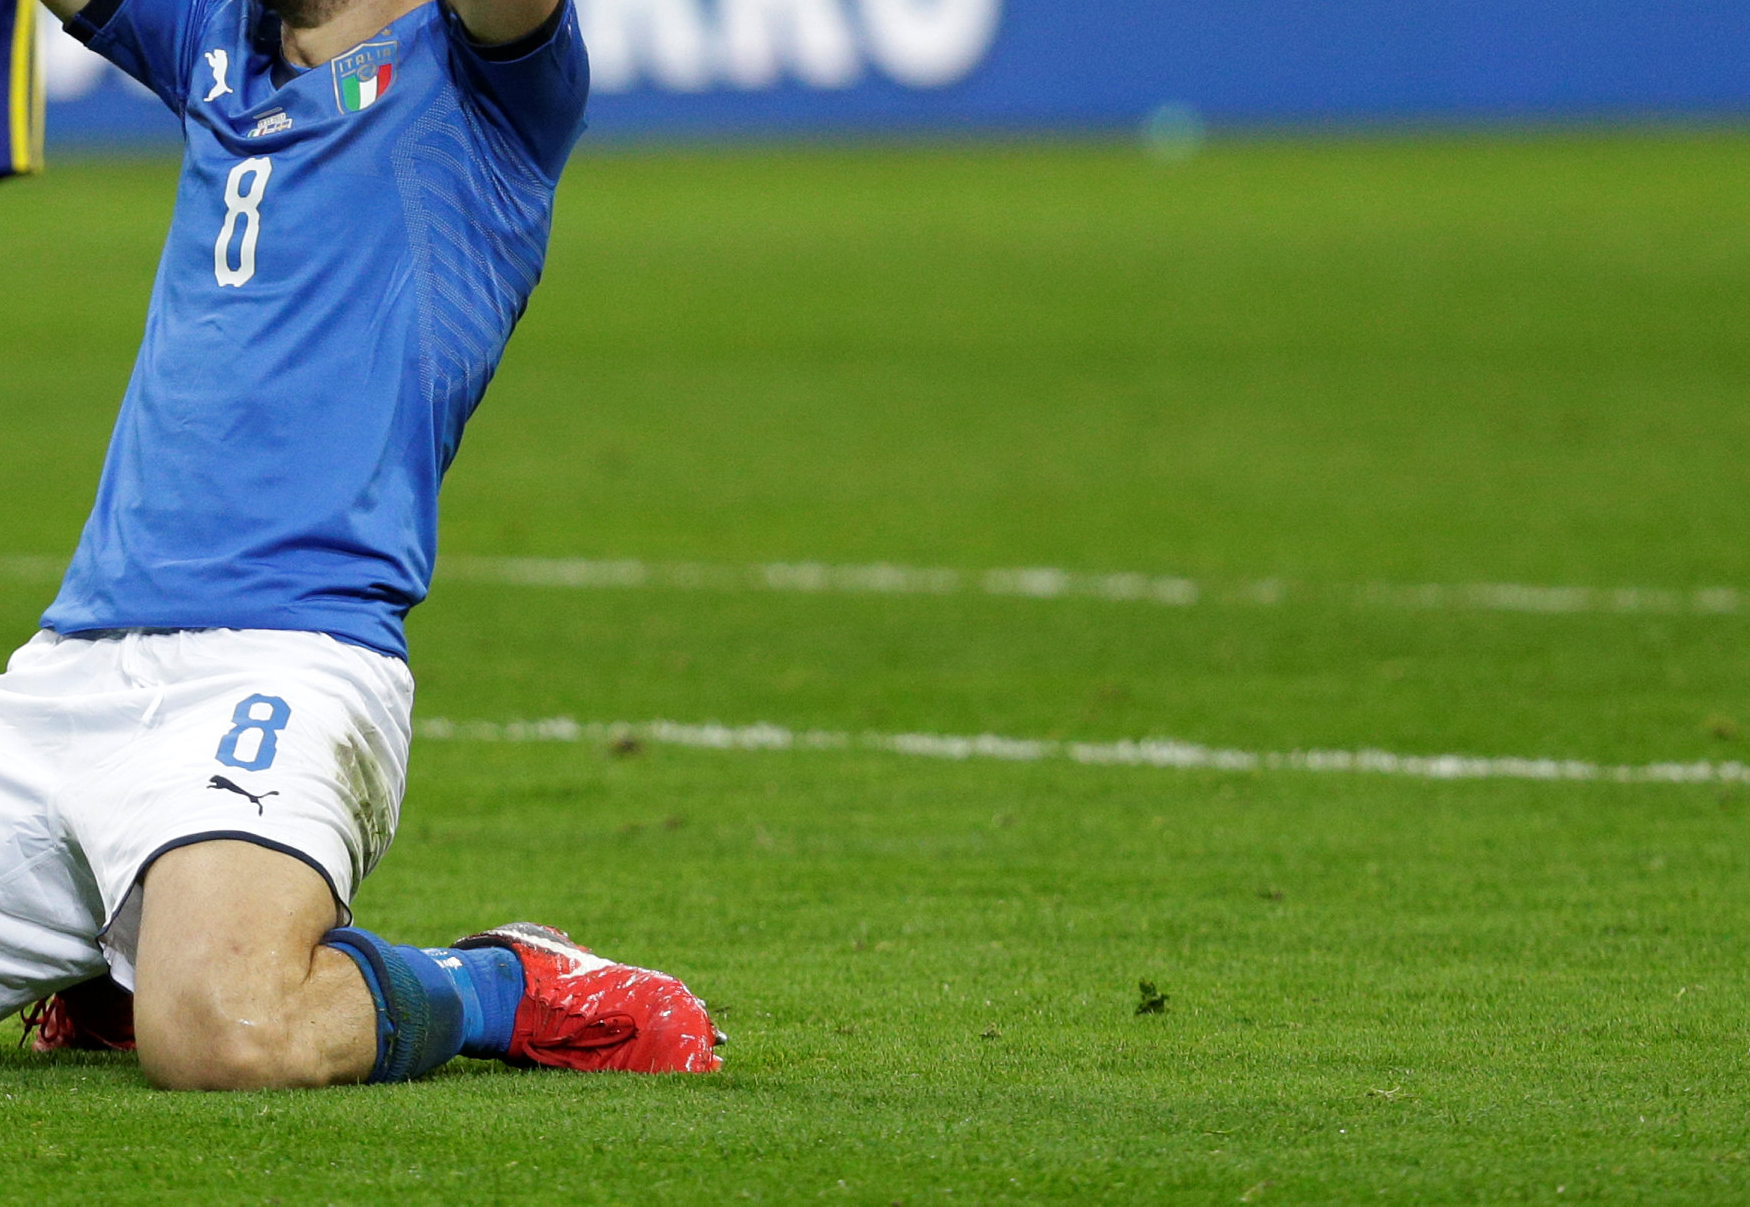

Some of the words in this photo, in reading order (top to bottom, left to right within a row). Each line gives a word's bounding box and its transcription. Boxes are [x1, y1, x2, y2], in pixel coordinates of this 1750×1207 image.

[338, 47, 391, 73] ITALIA
[214, 156, 272, 288] 8
[215, 693, 291, 772] 8
